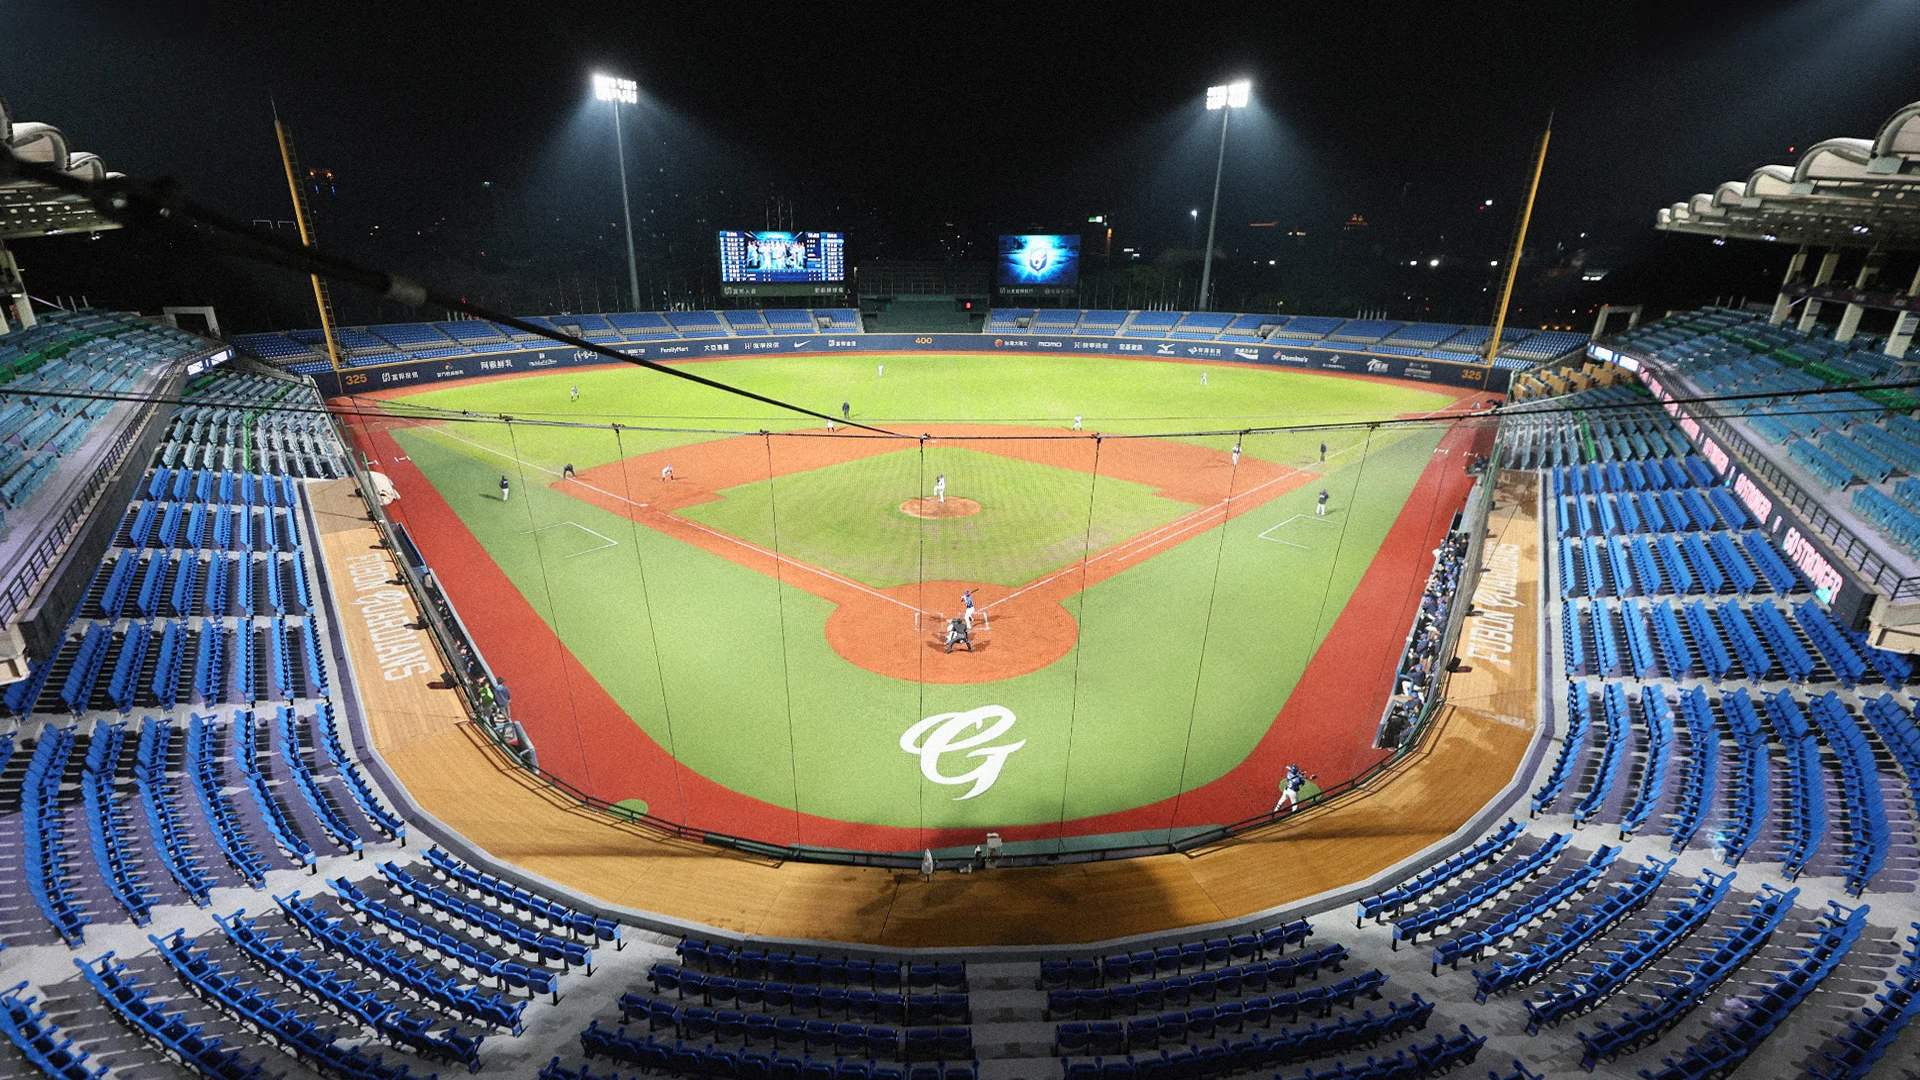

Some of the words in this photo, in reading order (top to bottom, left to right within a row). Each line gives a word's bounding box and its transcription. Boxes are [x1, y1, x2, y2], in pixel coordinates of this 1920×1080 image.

[915, 337, 933, 345] 400
[660, 346, 690, 354] FamilyMart
[1280, 354, 1309, 363] Domino's
[345, 373, 368, 386] 325
[1461, 369, 1483, 381] 325
[347, 553, 393, 593] FUBON
[349, 590, 433, 681] GUARDIANS
[1467, 606, 1515, 665] FUBON
